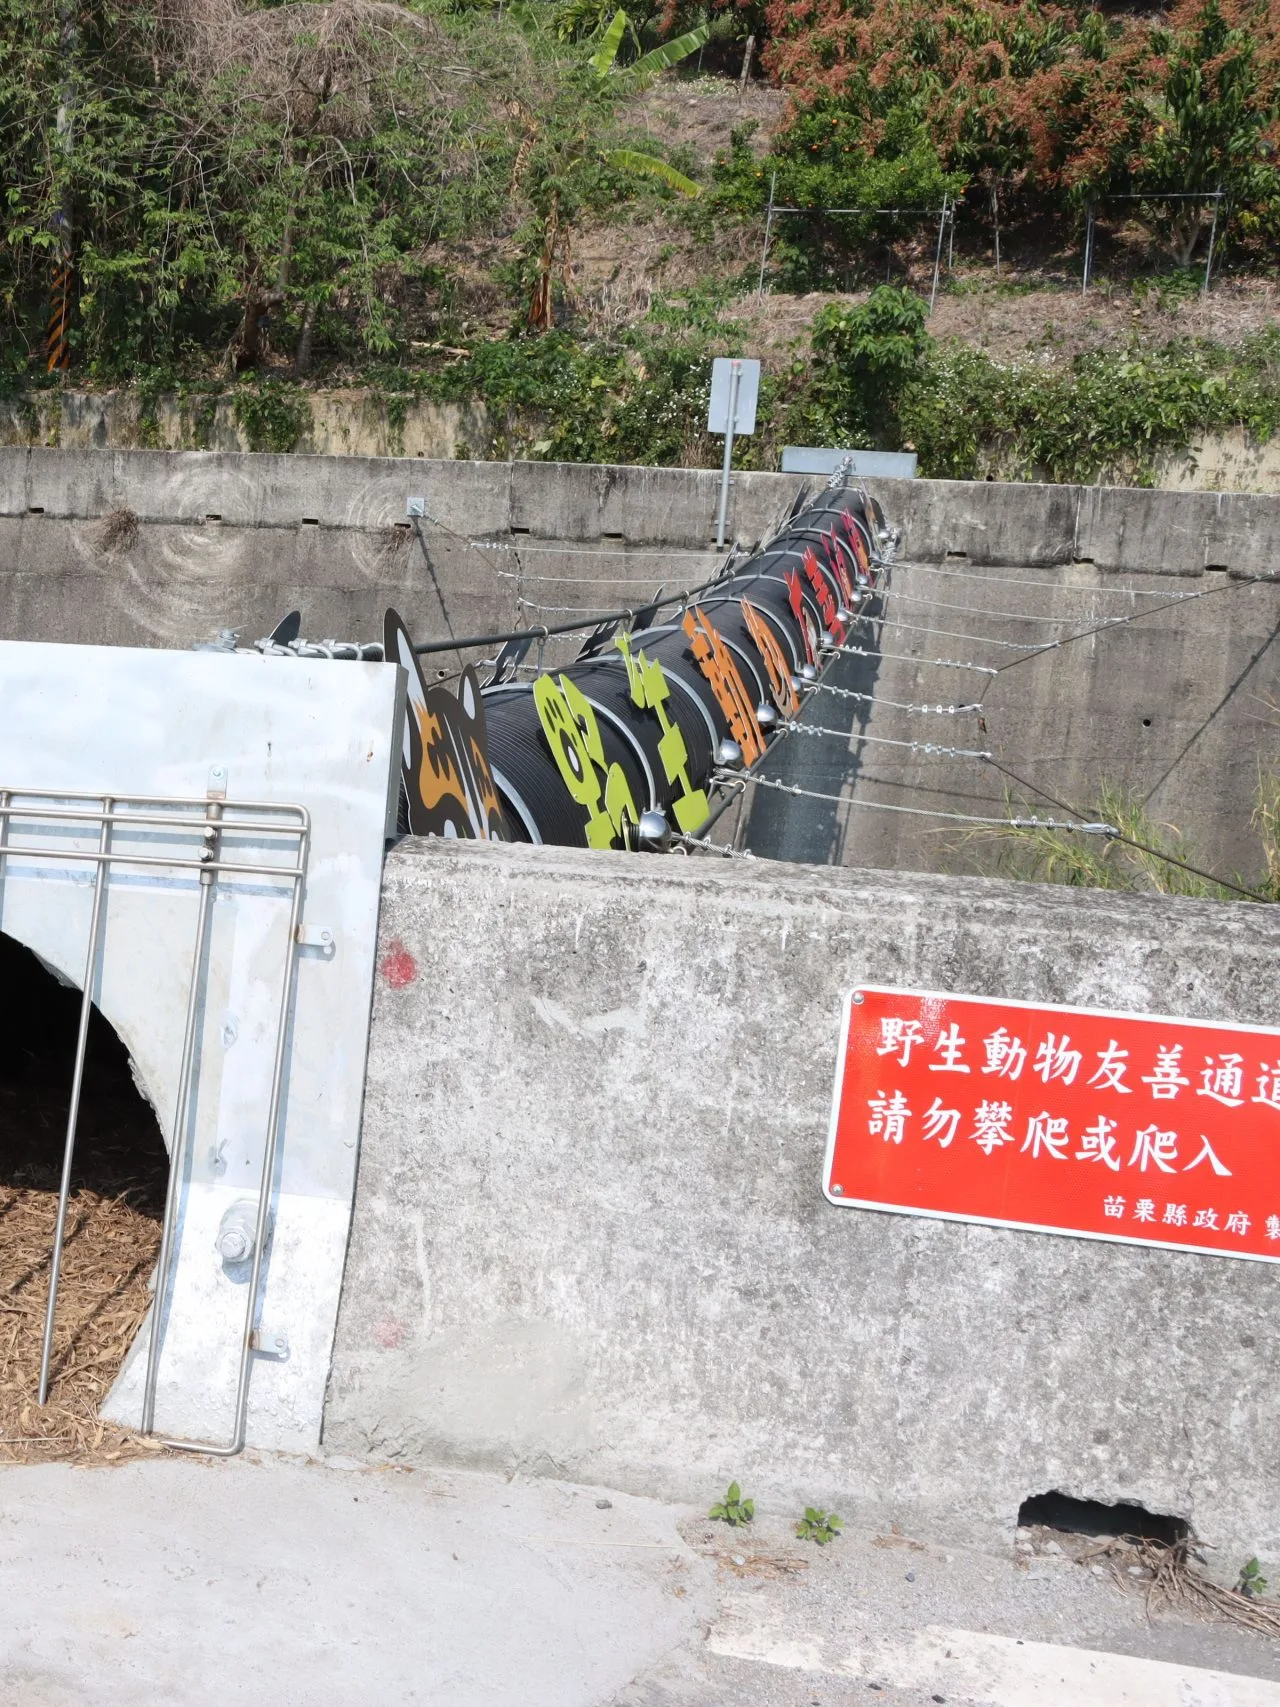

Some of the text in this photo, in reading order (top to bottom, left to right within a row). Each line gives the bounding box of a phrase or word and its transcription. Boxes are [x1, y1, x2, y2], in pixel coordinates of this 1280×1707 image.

[876, 1016, 1280, 1112] 野生動物友善通道
[867, 1089, 1233, 1176] 請勿攀爬或爬入
